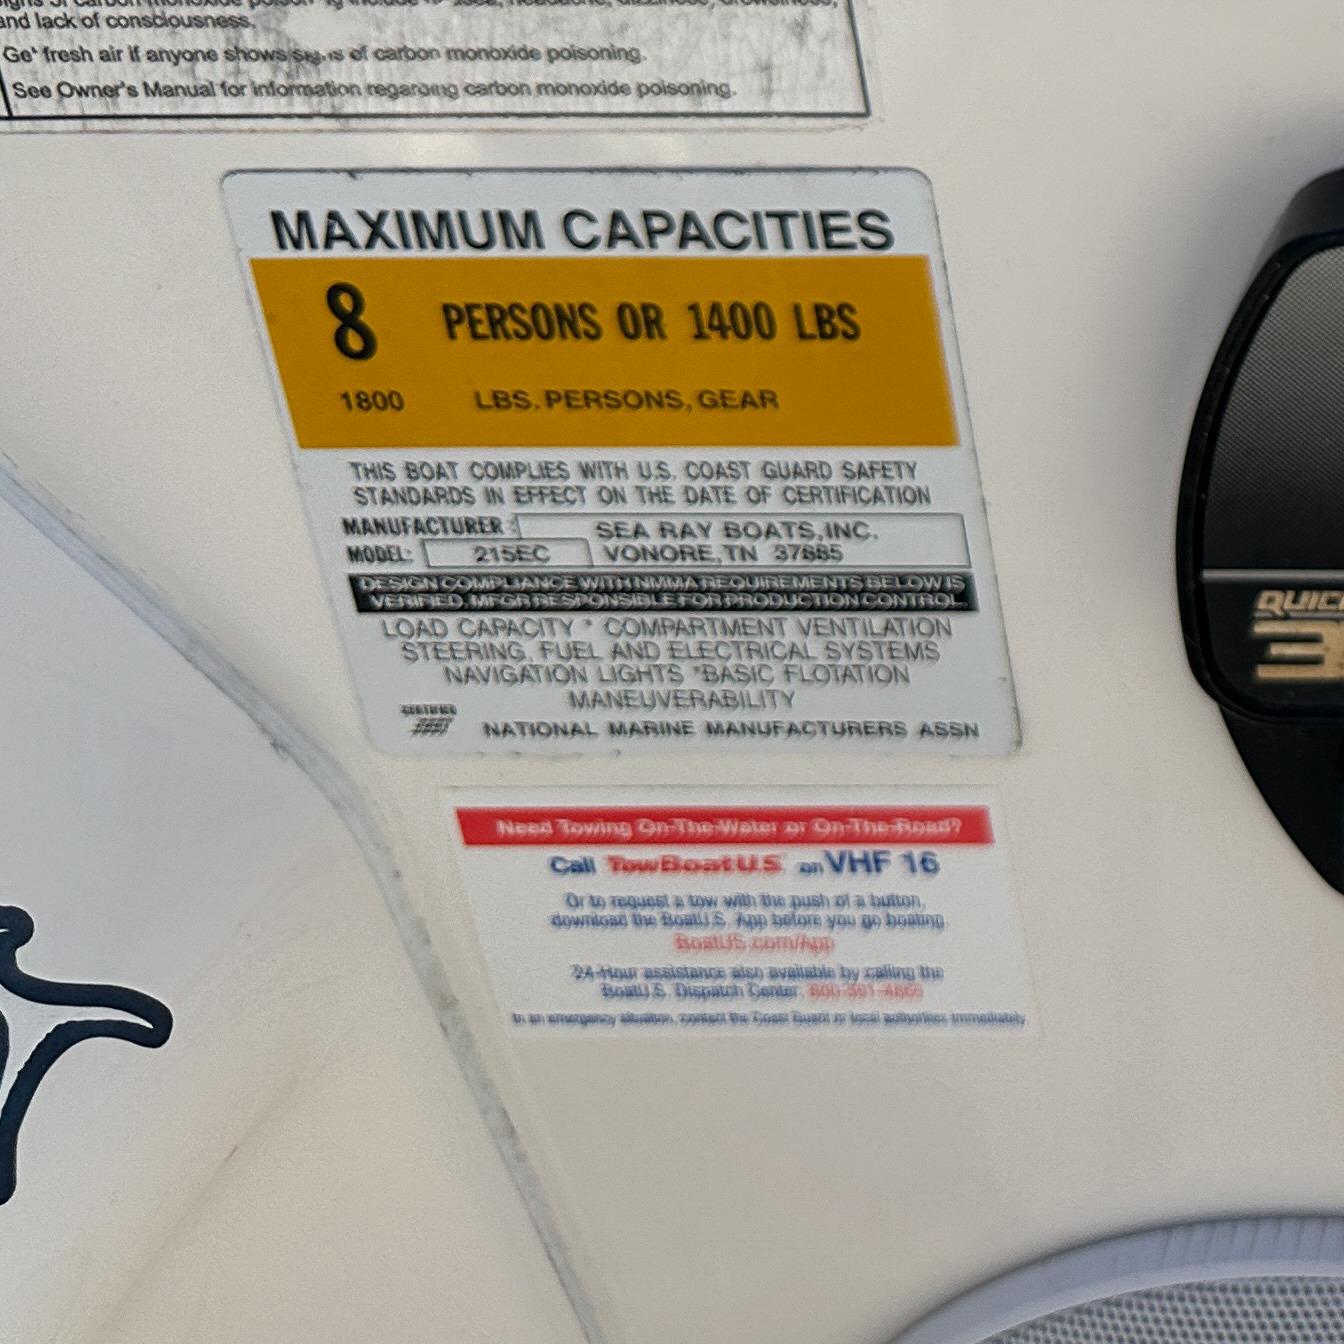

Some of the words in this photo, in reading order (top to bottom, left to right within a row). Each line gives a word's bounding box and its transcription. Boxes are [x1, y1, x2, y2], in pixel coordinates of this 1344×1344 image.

[12, 82, 52, 100] See
[56, 81, 138, 99] Owner's
[143, 81, 216, 99] Manual
[220, 81, 247, 99] for
[252, 81, 361, 99] information
[462, 80, 532, 98] carbon
[535, 79, 632, 98] monoxide
[635, 79, 737, 100] poisoning.
[269, 209, 546, 252] MAXIMUM
[560, 208, 895, 252] CAPACITIES
[326, 282, 379, 360] 8
[441, 301, 604, 342] PERSONS
[615, 301, 667, 341] OR
[687, 301, 777, 341] 1400
[792, 302, 862, 342] LBS
[339, 389, 406, 413] 1800
[473, 389, 541, 412] LBS.
[543, 388, 693, 414] PERSONS,
[695, 388, 780, 411] GEAR
[348, 460, 397, 482] THIS
[402, 460, 459, 482] BOAT
[467, 460, 571, 482] COMPLIES
[576, 460, 630, 482] WITH
[636, 460, 677, 482] U.S.
[683, 460, 751, 482] COAST
[760, 460, 833, 482] GUARD
[840, 460, 917, 482] SAFETY
[351, 484, 477, 506] STANDARDS
[482, 484, 506, 506] IN
[511, 484, 587, 506] EFFECT
[595, 484, 628, 506] ON
[634, 484, 676, 506] THE
[681, 484, 738, 506] DATE
[743, 484, 772, 506] OF
[780, 484, 932, 506] CERTIFICATION
[597, 520, 648, 540] SEA
[658, 520, 712, 541] RAY
[474, 545, 551, 563] 215EC
[381, 617, 448, 638] LOAD
[457, 617, 574, 639] CAPACITY
[603, 617, 788, 639] COMPARTMENT
[797, 616, 953, 639] VENTILATION
[538, 641, 601, 661] FUEL
[611, 641, 661, 661] AND
[668, 640, 818, 662] ELECTRICAL
[824, 640, 941, 662] SYSTEMS
[444, 664, 587, 685] NAVIGATION
[599, 664, 684, 685] LIGHTS
[785, 664, 911, 685] FLOTATION
[569, 689, 796, 710] MANEUVERABILITY
[482, 721, 599, 740] NATIONAL
[606, 719, 695, 739] MARINE
[704, 720, 908, 739] MANUFACTURERS
[916, 721, 980, 740] ASSN
[496, 819, 551, 834] Need
[556, 819, 632, 837] Towing
[638, 818, 777, 833] On-The-Water
[785, 821, 806, 833] or
[812, 817, 962, 834] On-The-Road?
[550, 856, 595, 874] Call
[799, 860, 823, 874] on
[824, 849, 892, 873] VHF
[902, 850, 941, 874] 16
